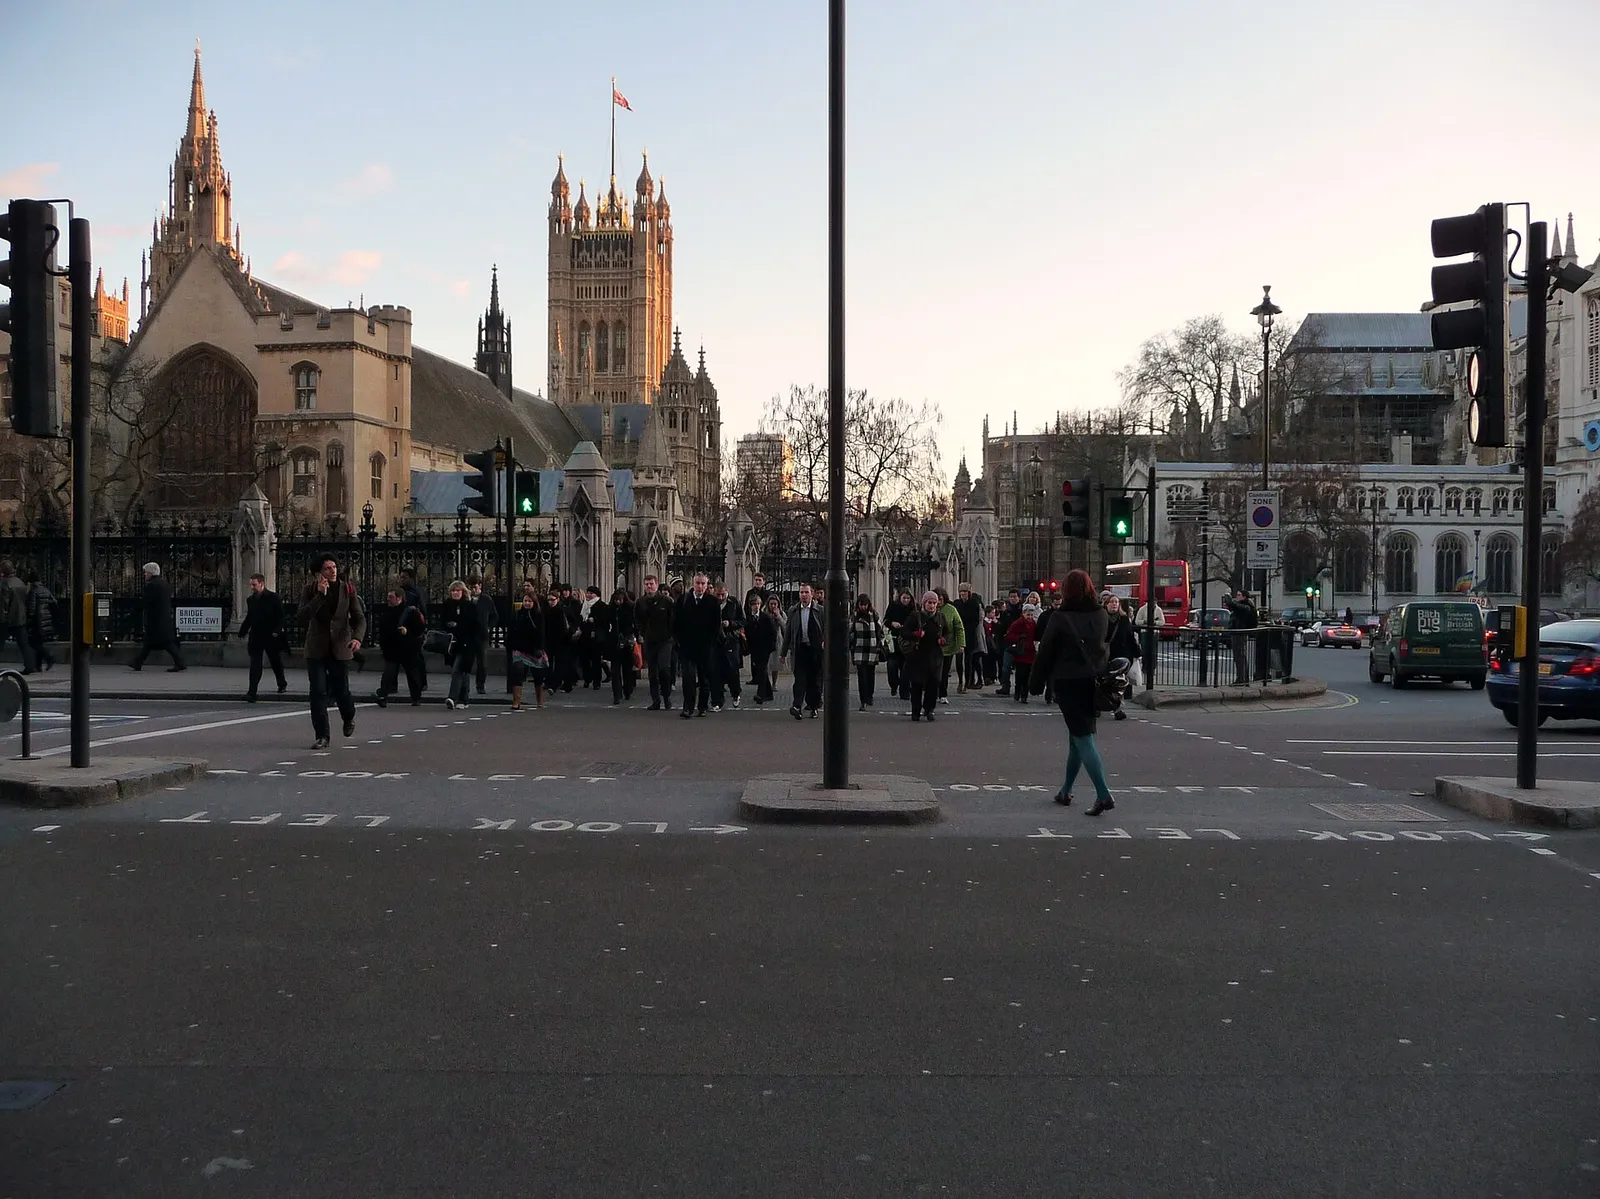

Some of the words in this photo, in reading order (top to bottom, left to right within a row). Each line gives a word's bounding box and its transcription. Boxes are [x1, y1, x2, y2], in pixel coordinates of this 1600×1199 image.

[179, 609, 204, 617] BRIDGE
[179, 617, 203, 625] STREET
[205, 617, 219, 625] SW1
[1417, 617, 1440, 633] pig
[258, 770, 410, 779] LOOK
[448, 774, 617, 783] LEFT
[159, 811, 390, 827] LEFT
[471, 817, 669, 833] LOOK
[1027, 827, 1241, 840] LEFT
[1298, 829, 1492, 841] LOOK
